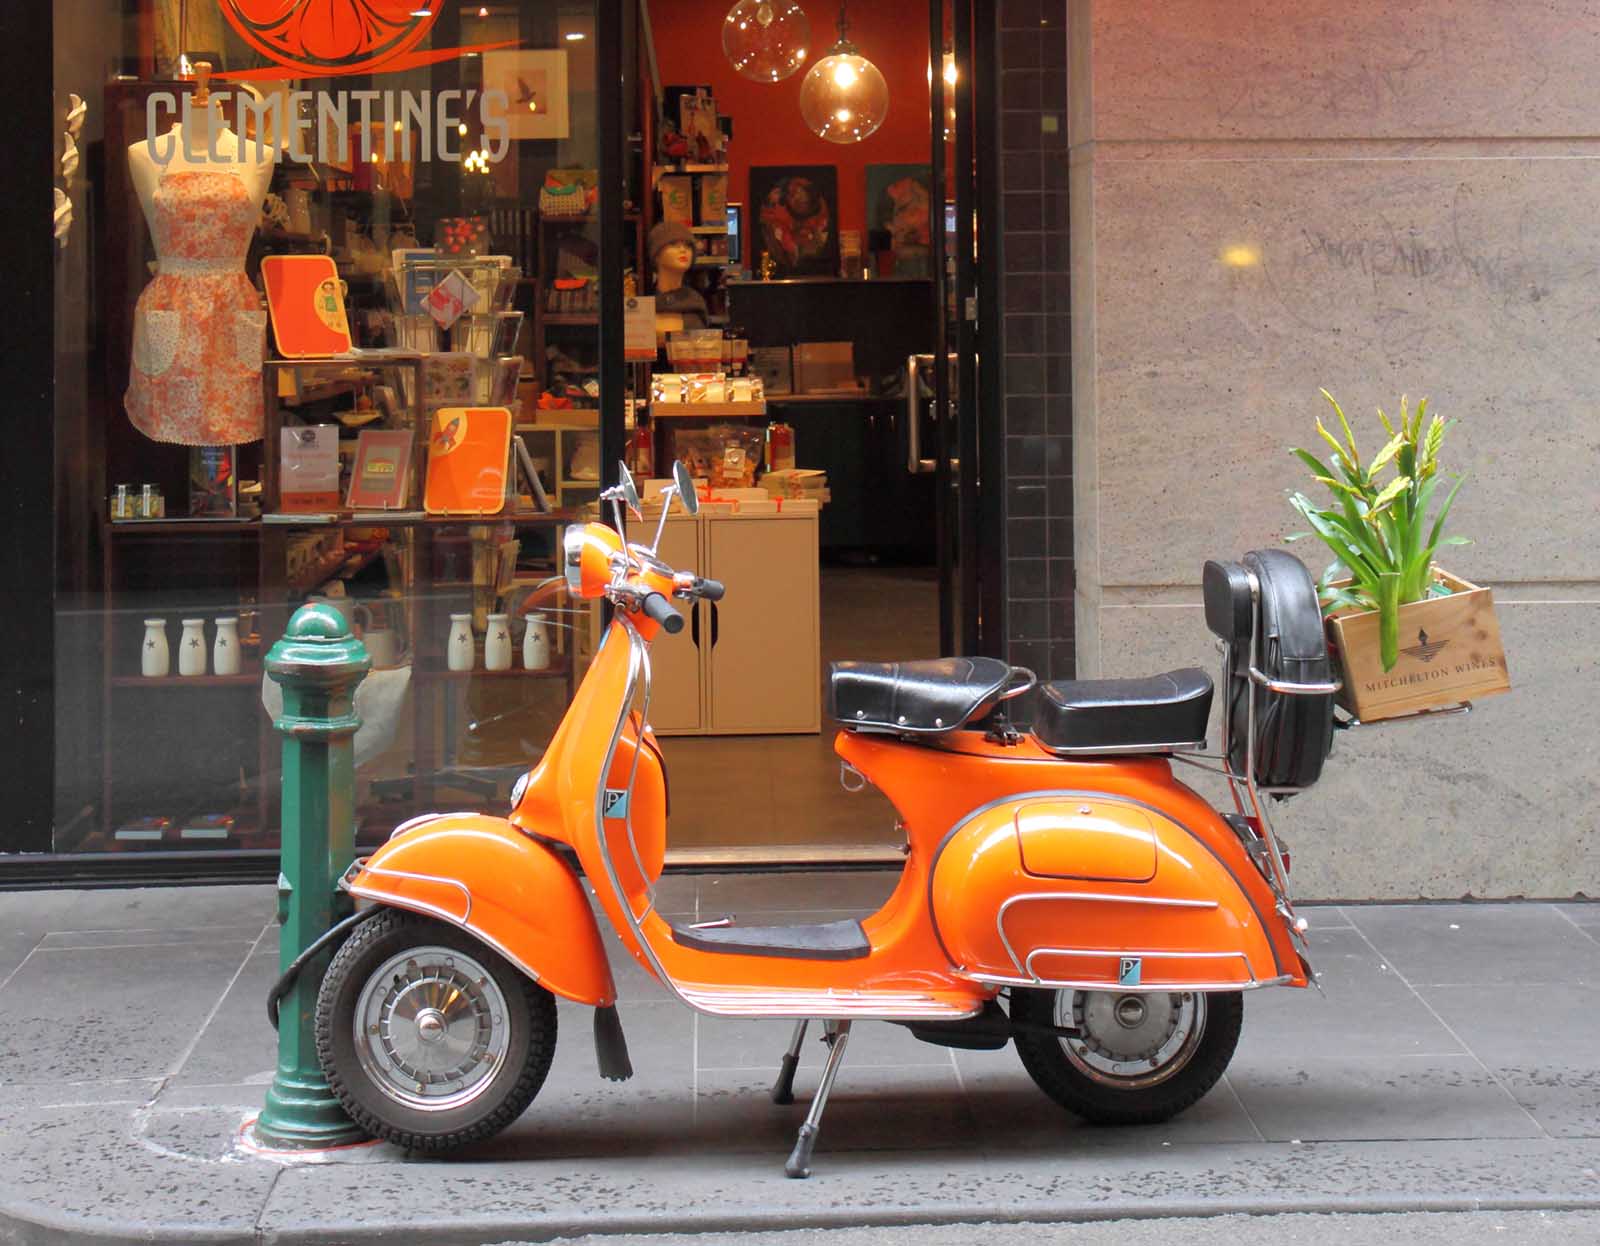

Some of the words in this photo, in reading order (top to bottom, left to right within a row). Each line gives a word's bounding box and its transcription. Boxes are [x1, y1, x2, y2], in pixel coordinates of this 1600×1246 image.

[146, 89, 510, 165] CLEMENTINE'S
[1365, 668, 1449, 692] MITCHELTON
[1455, 656, 1496, 673] WINES
